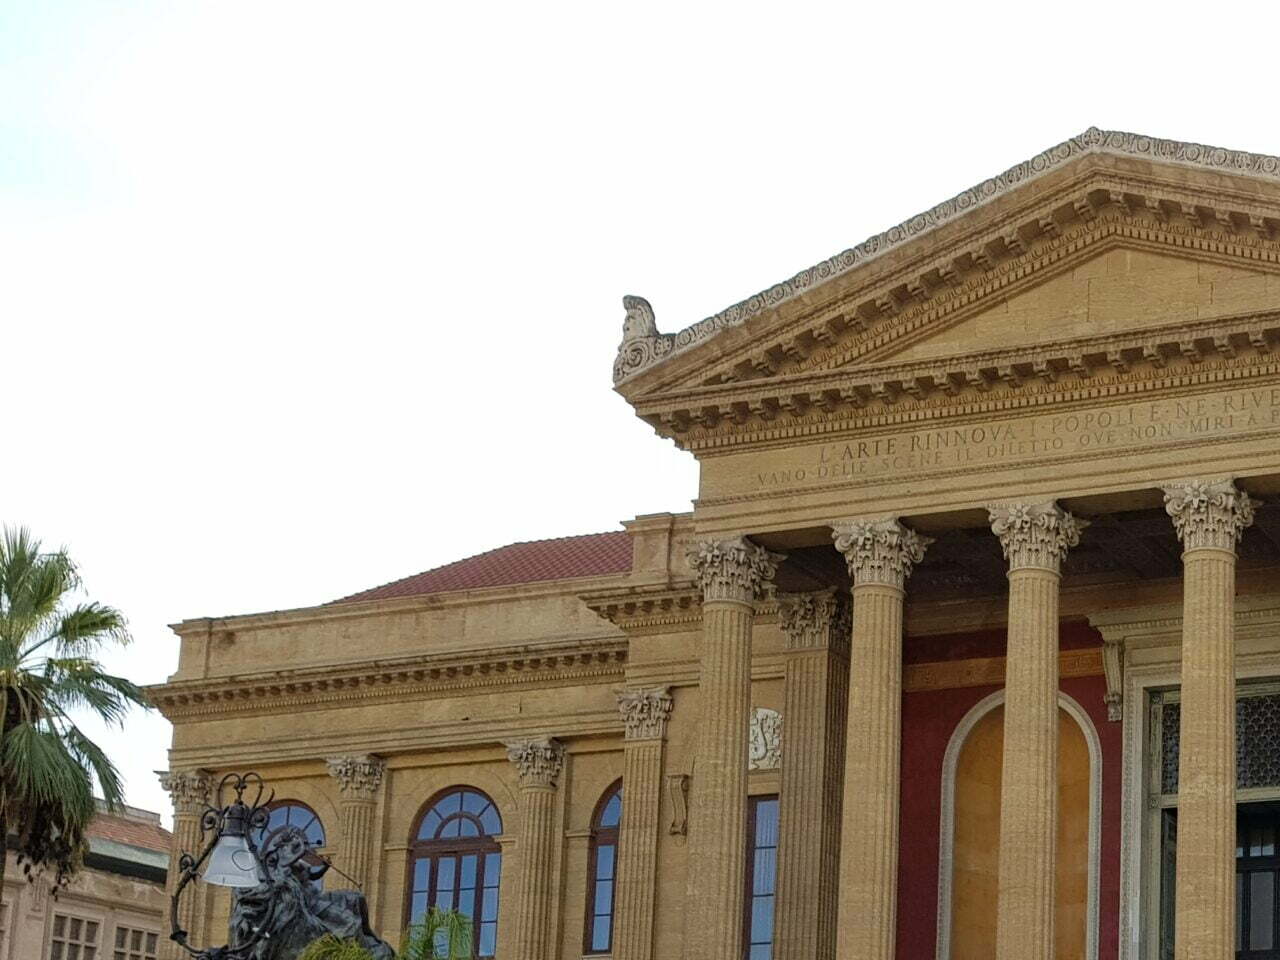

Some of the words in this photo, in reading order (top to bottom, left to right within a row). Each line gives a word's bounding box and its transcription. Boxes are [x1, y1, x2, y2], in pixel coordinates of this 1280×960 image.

[758, 469, 806, 486] VANO
[817, 460, 868, 478] DELLE
[882, 450, 943, 470] SCENE
[1079, 430, 1116, 446] OVE
[1130, 423, 1172, 441] NON
[1190, 415, 1233, 434] MIRI
[911, 424, 1016, 451] RINNOVA
[1051, 408, 1134, 434] POPOLI
[1176, 399, 1206, 419] NE
